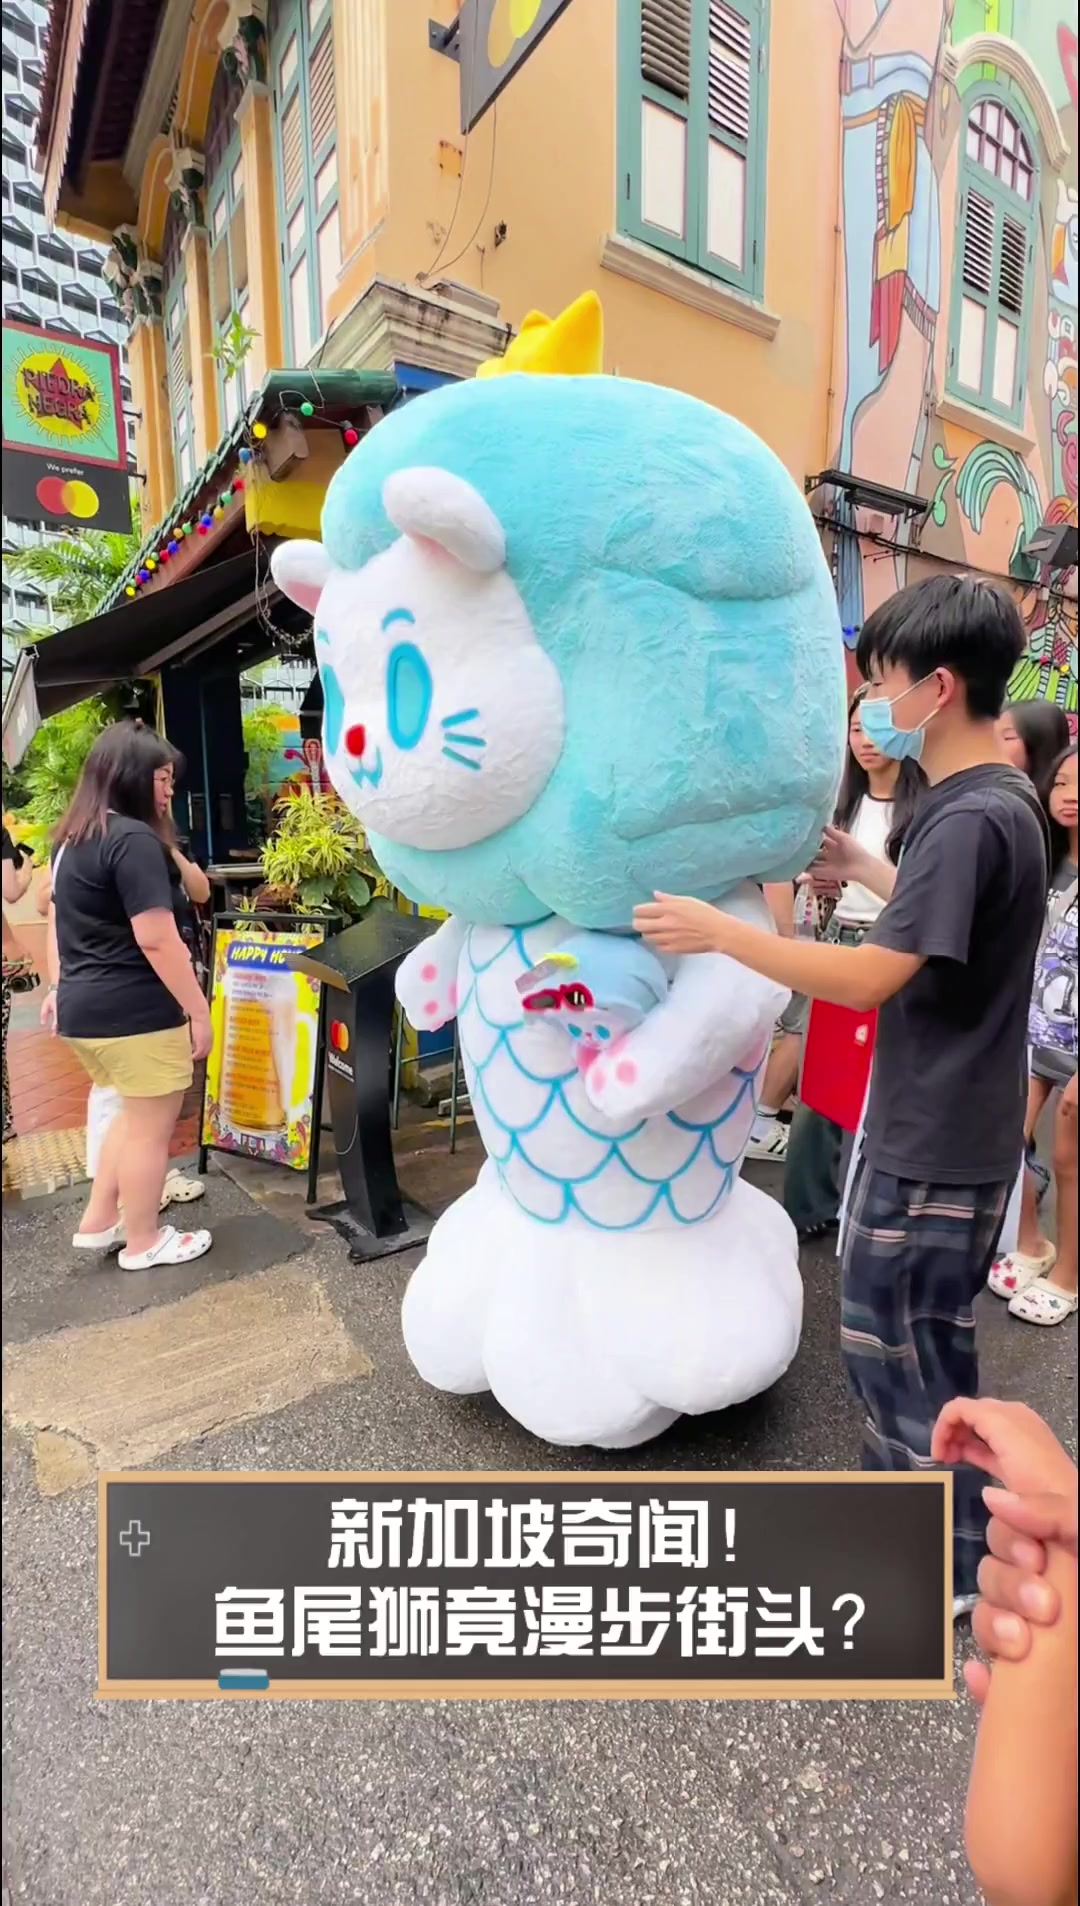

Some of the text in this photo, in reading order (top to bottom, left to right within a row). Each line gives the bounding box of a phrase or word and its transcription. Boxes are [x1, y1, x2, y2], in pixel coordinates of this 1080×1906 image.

[21, 367, 96, 403] PIEDRA
[46, 463, 84, 476] We prefer
[231, 945, 268, 963] HAPPY
[328, 1051, 353, 1076] Welcome
